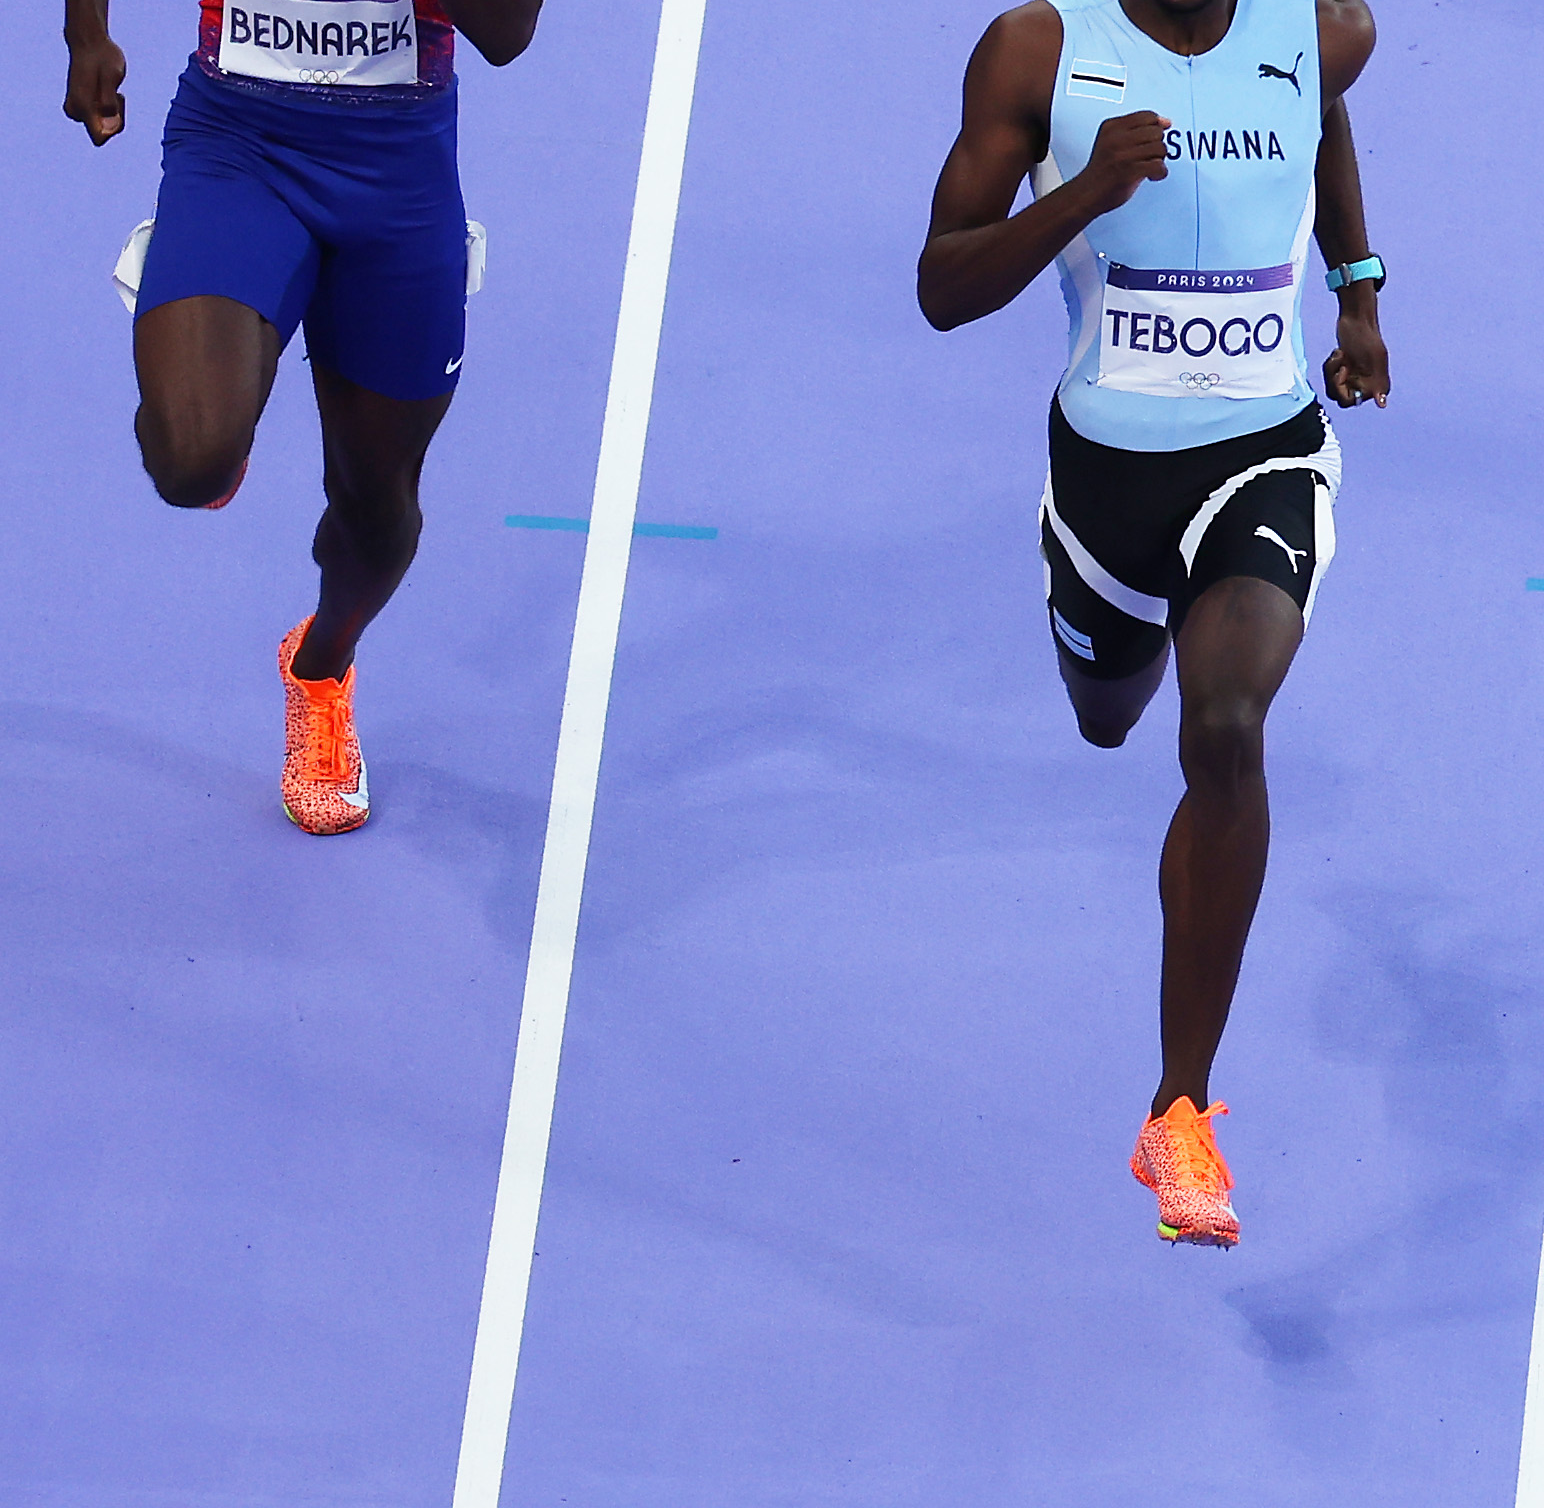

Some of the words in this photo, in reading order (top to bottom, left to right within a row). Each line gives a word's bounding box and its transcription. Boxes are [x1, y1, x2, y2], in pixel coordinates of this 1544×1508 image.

[230, 7, 413, 56] BEDNAREK
[1166, 128, 1286, 161] SWANA
[1157, 274, 1206, 287] PARIS
[1212, 275, 1255, 287] 2024
[1105, 308, 1284, 357] TEBOGO
